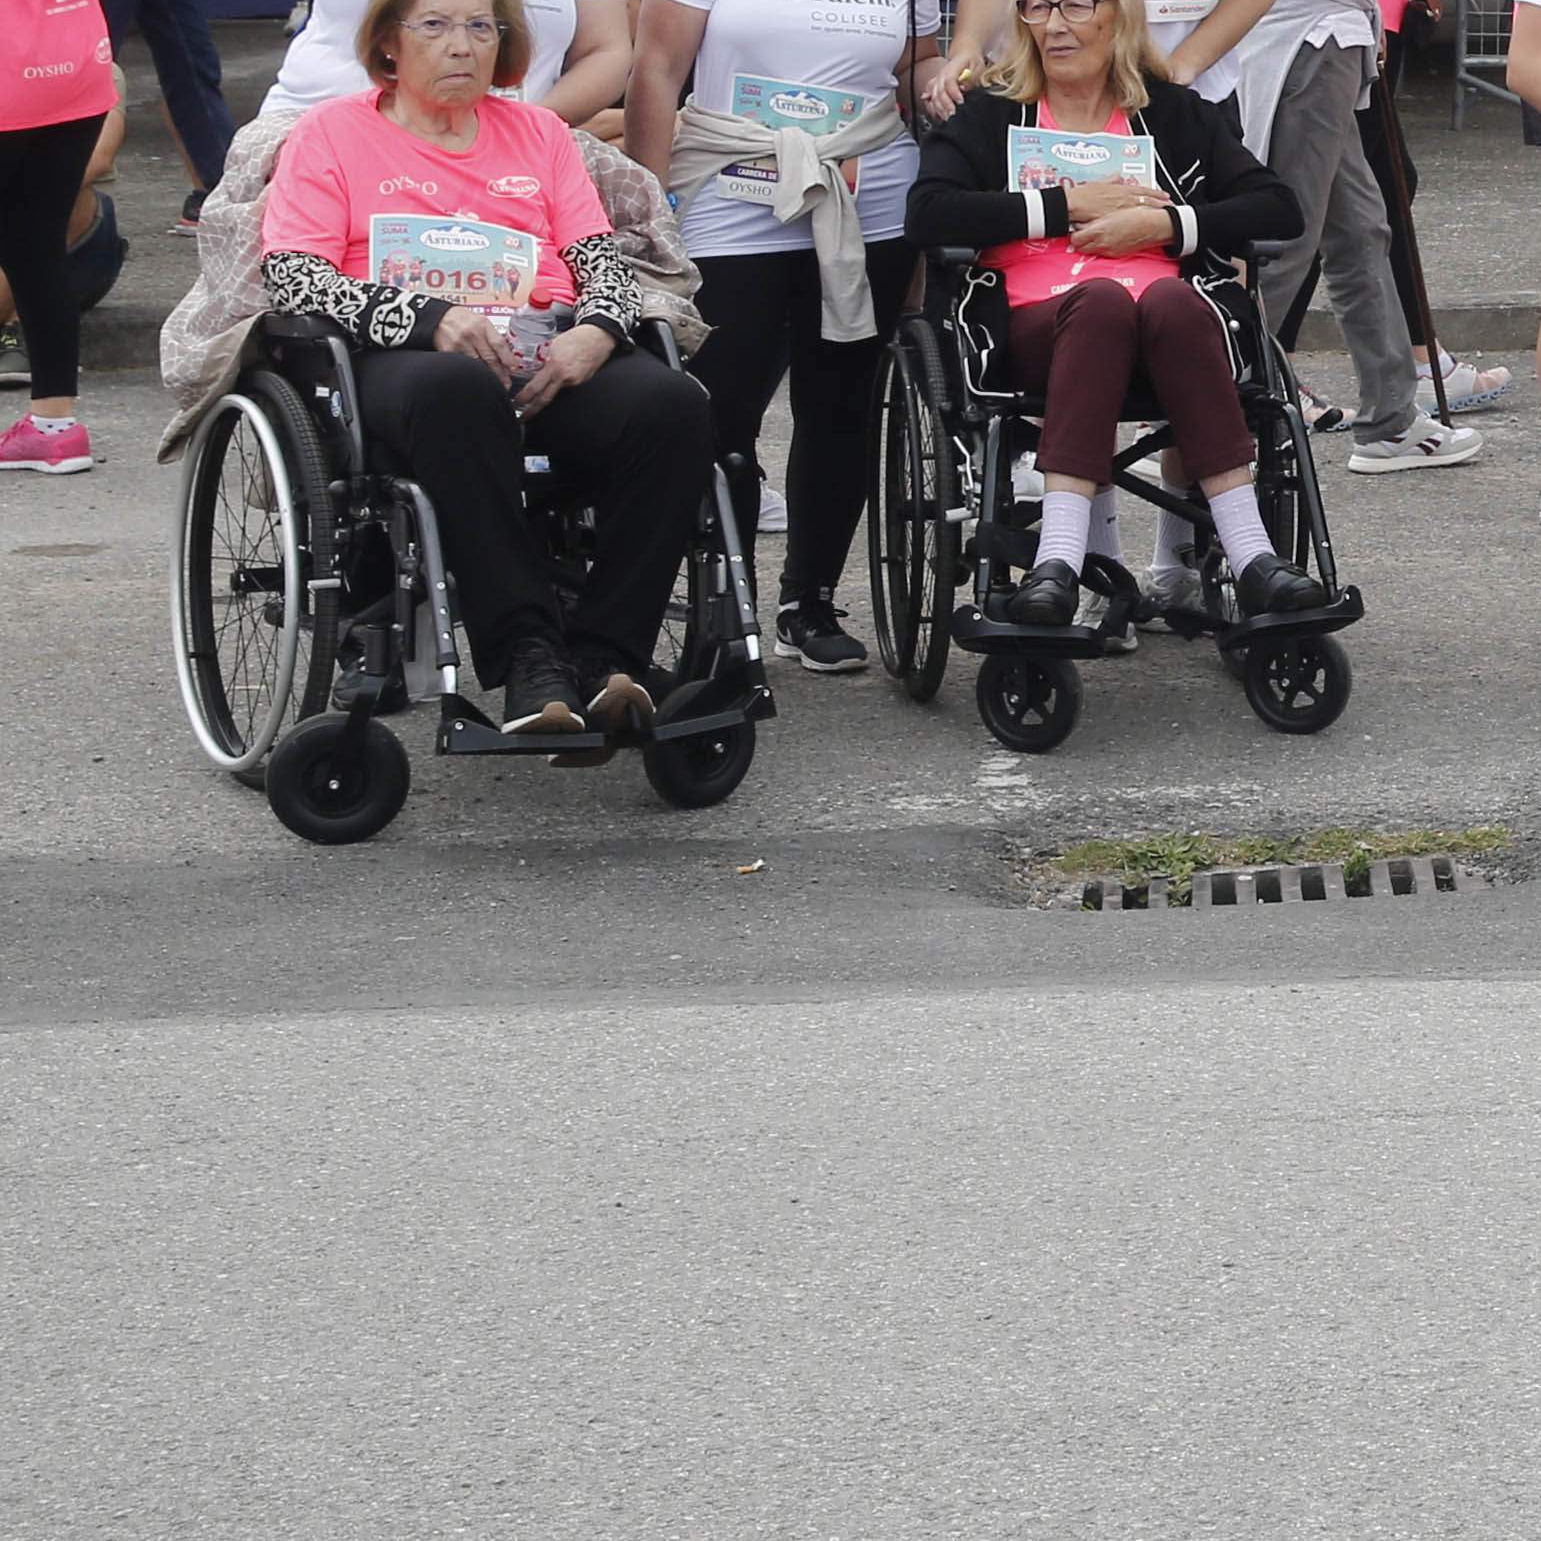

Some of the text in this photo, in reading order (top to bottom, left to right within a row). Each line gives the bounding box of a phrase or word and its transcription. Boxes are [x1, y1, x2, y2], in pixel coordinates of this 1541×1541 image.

[811, 10, 889, 27] COLISEE
[24, 62, 74, 79] OYSHO
[1055, 147, 1109, 160] ASTURIANA
[736, 167, 767, 179] CARRERA
[379, 176, 438, 196] OYSO
[729, 181, 772, 197] OYSHO
[423, 233, 487, 247] ASTURIANA
[425, 269, 487, 290] 016
